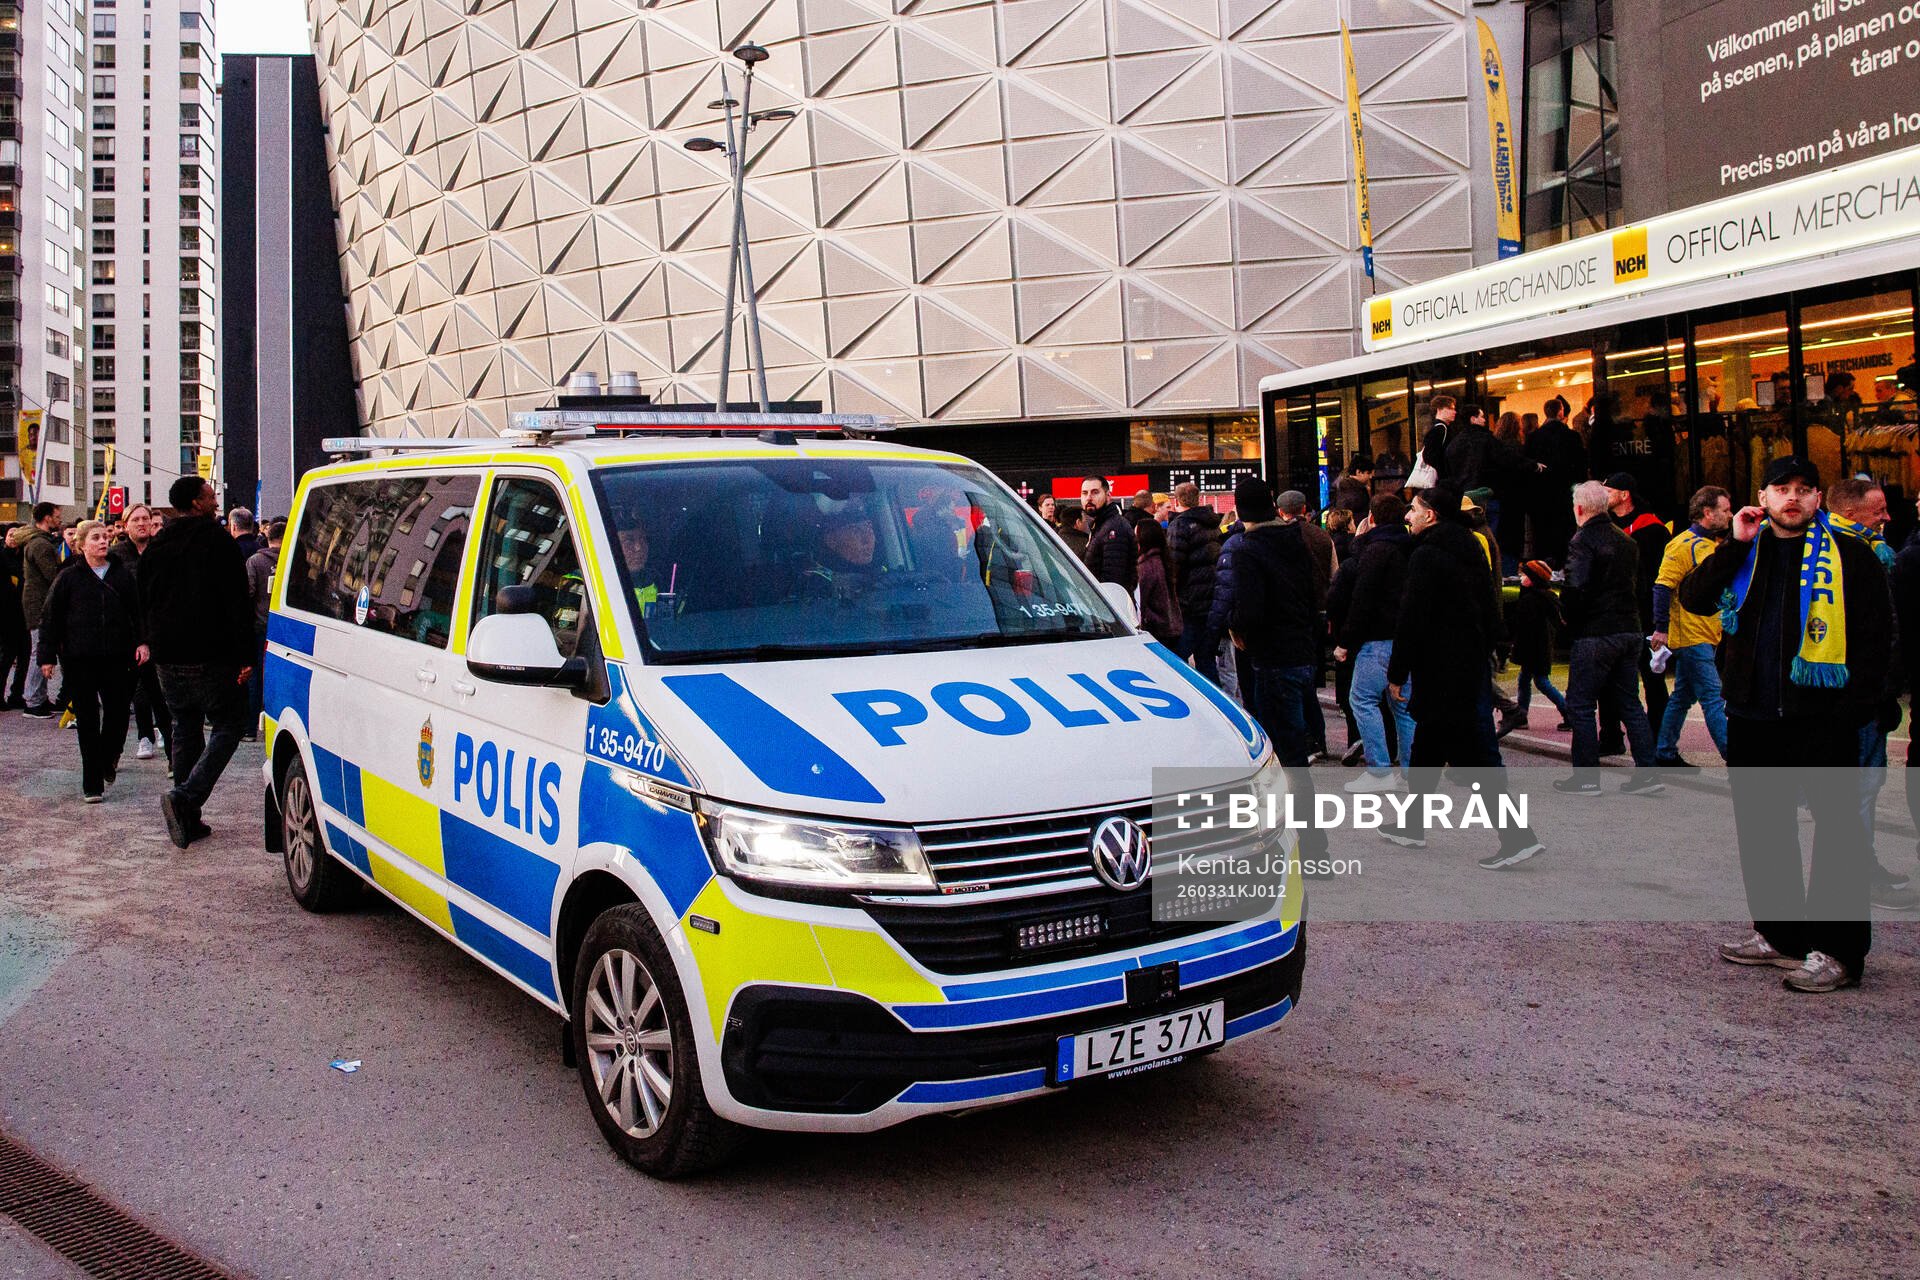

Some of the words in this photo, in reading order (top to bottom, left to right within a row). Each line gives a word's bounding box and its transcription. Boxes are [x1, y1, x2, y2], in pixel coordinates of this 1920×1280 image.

[1701, 71, 1722, 103] på
[1724, 52, 1794, 89] scenen,
[1797, 33, 1822, 68] på
[1825, 12, 1895, 58] planen
[1707, 10, 1809, 63] Välkommen
[1812, 0, 1835, 22] till
[1850, 45, 1902, 77] tårar
[1721, 154, 1773, 185] Precis
[1776, 144, 1815, 170] som
[1818, 129, 1844, 163] på
[1846, 121, 1890, 149] våra
[1667, 211, 1780, 264] OFFICIAL
[1403, 291, 1468, 327] OFFICIAL
[1475, 257, 1598, 311] MERCHANDISE
[831, 669, 1191, 747] POLIS
[588, 724, 597, 751] 1
[599, 727, 666, 773] 35-9470
[454, 731, 562, 846] POLIS
[649, 787, 687, 803] CARAVELLE
[1062, 1063, 1069, 1074] S
[1087, 1025, 1145, 1071] LZE
[1157, 1008, 1213, 1053] 37X
[1107, 1055, 1184, 1080] www.eurolans.se
